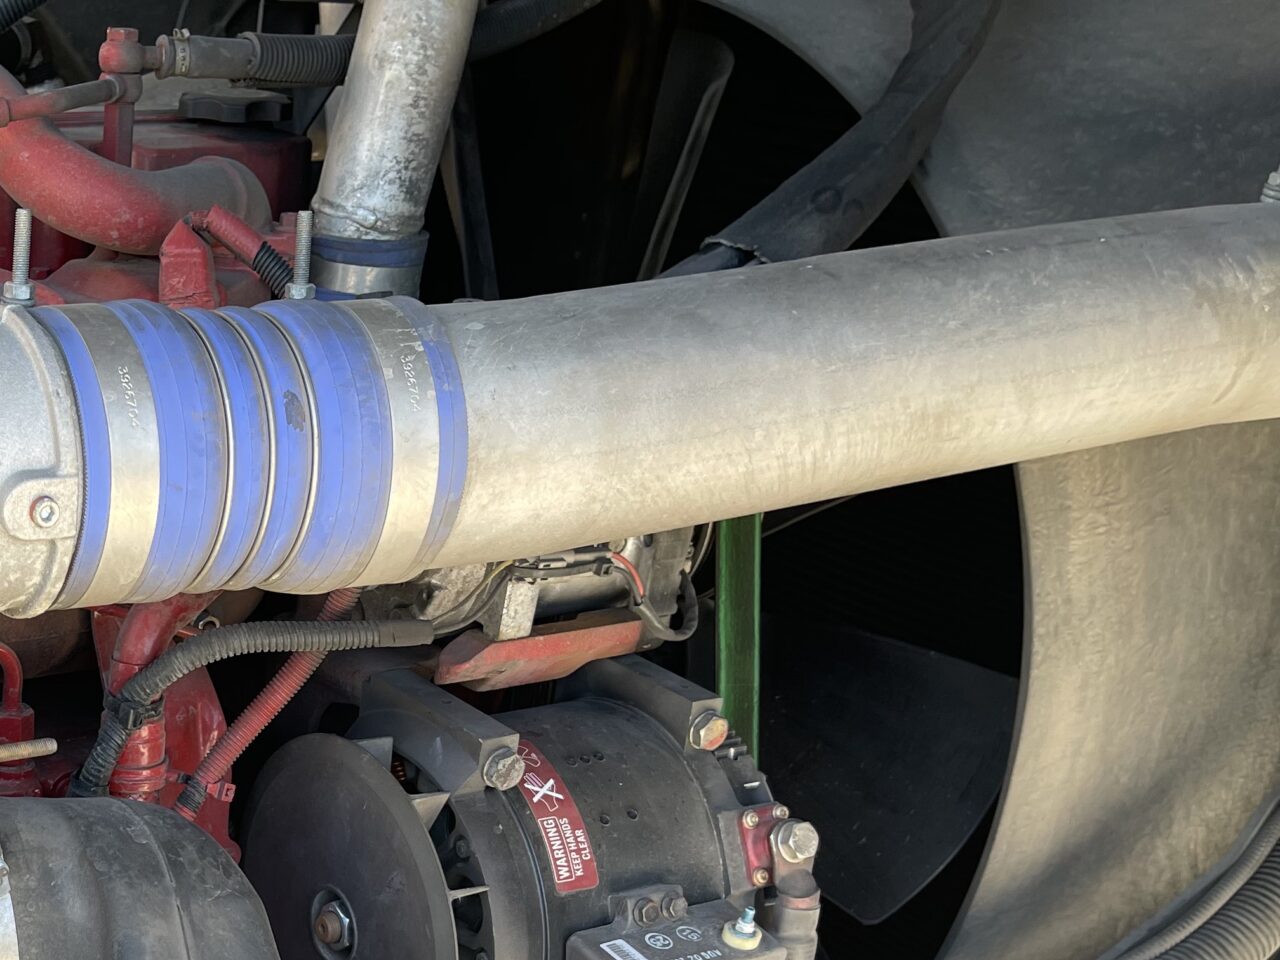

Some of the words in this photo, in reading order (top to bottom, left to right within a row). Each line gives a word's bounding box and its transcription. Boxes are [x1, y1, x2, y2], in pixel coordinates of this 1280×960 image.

[543, 819, 570, 879] WARNING
[559, 818, 577, 850] HANDS
[575, 829, 591, 860] CLEAR
[570, 852, 584, 876] KEEP
